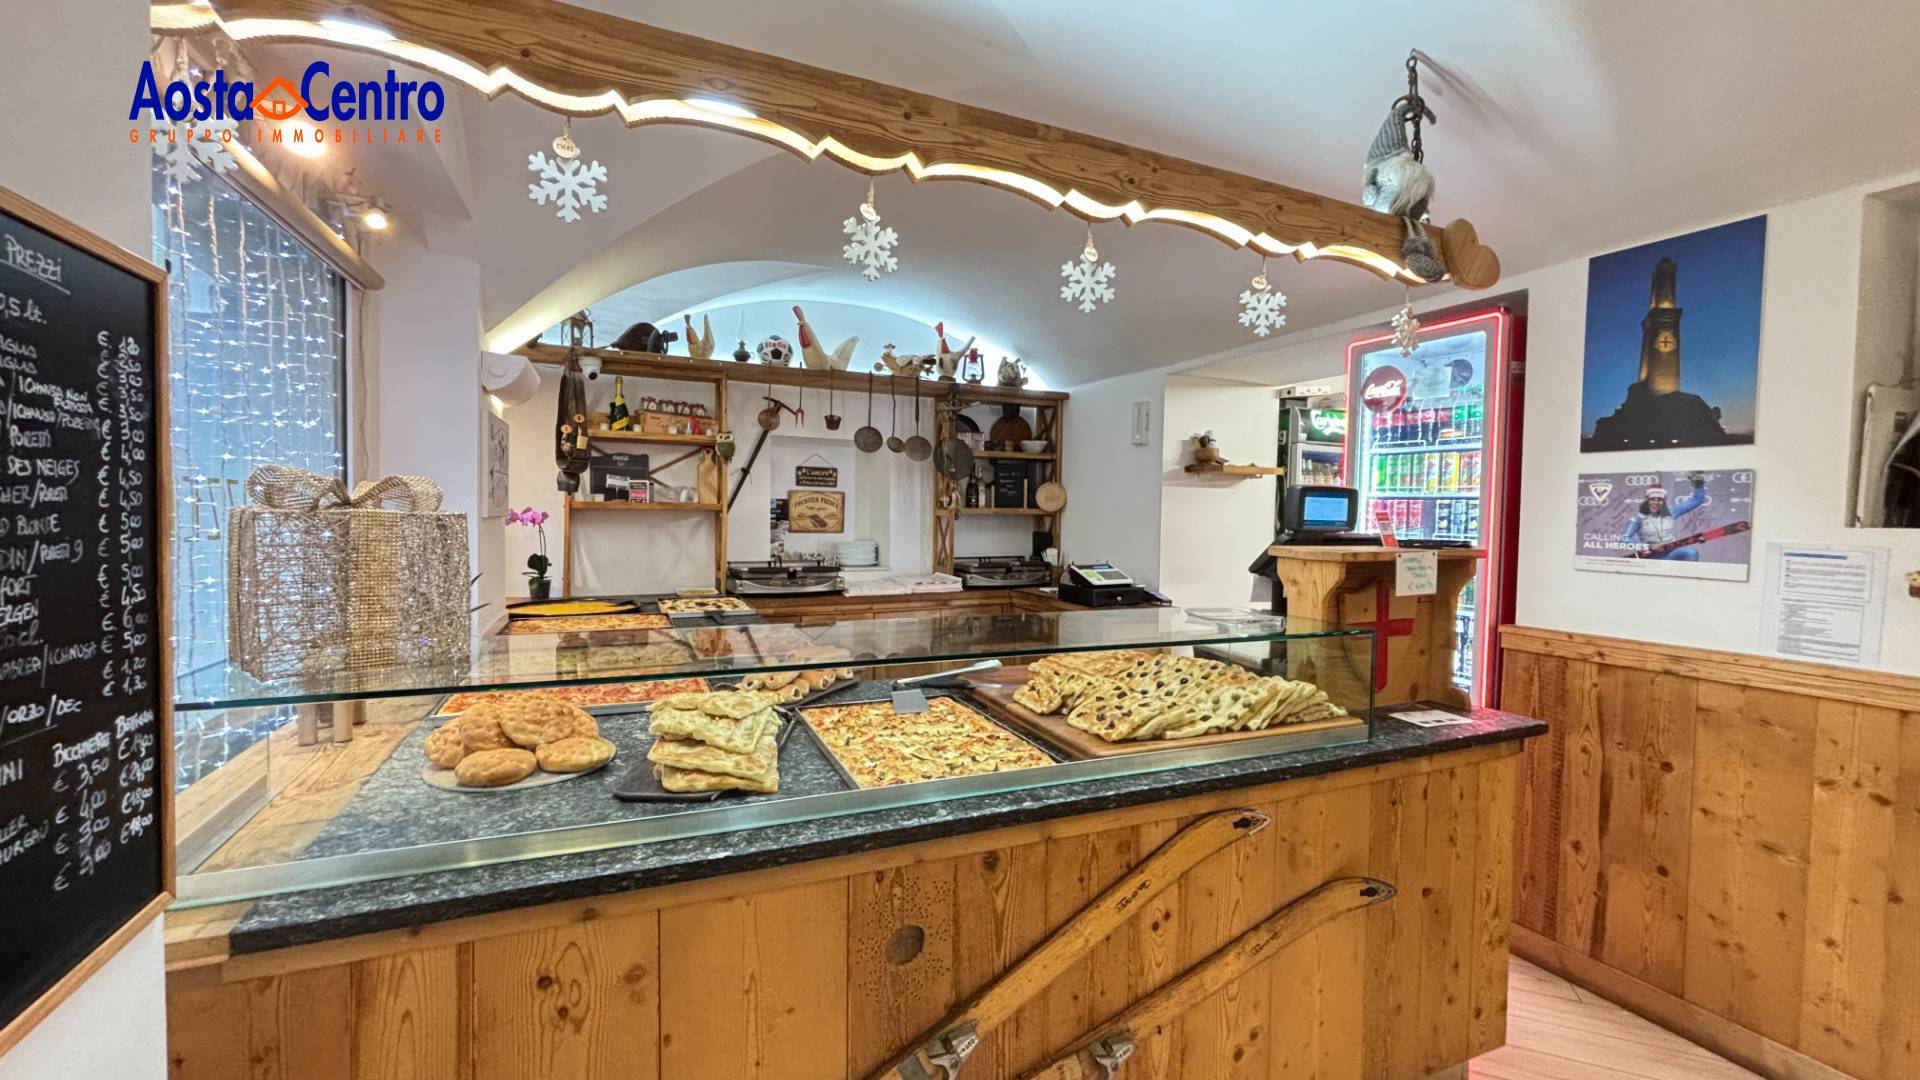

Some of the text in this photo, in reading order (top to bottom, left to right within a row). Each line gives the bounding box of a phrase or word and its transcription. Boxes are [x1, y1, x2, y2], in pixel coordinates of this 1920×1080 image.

[1583, 533, 1629, 542] CALLING
[1583, 541, 1650, 550] ALL HEROES
